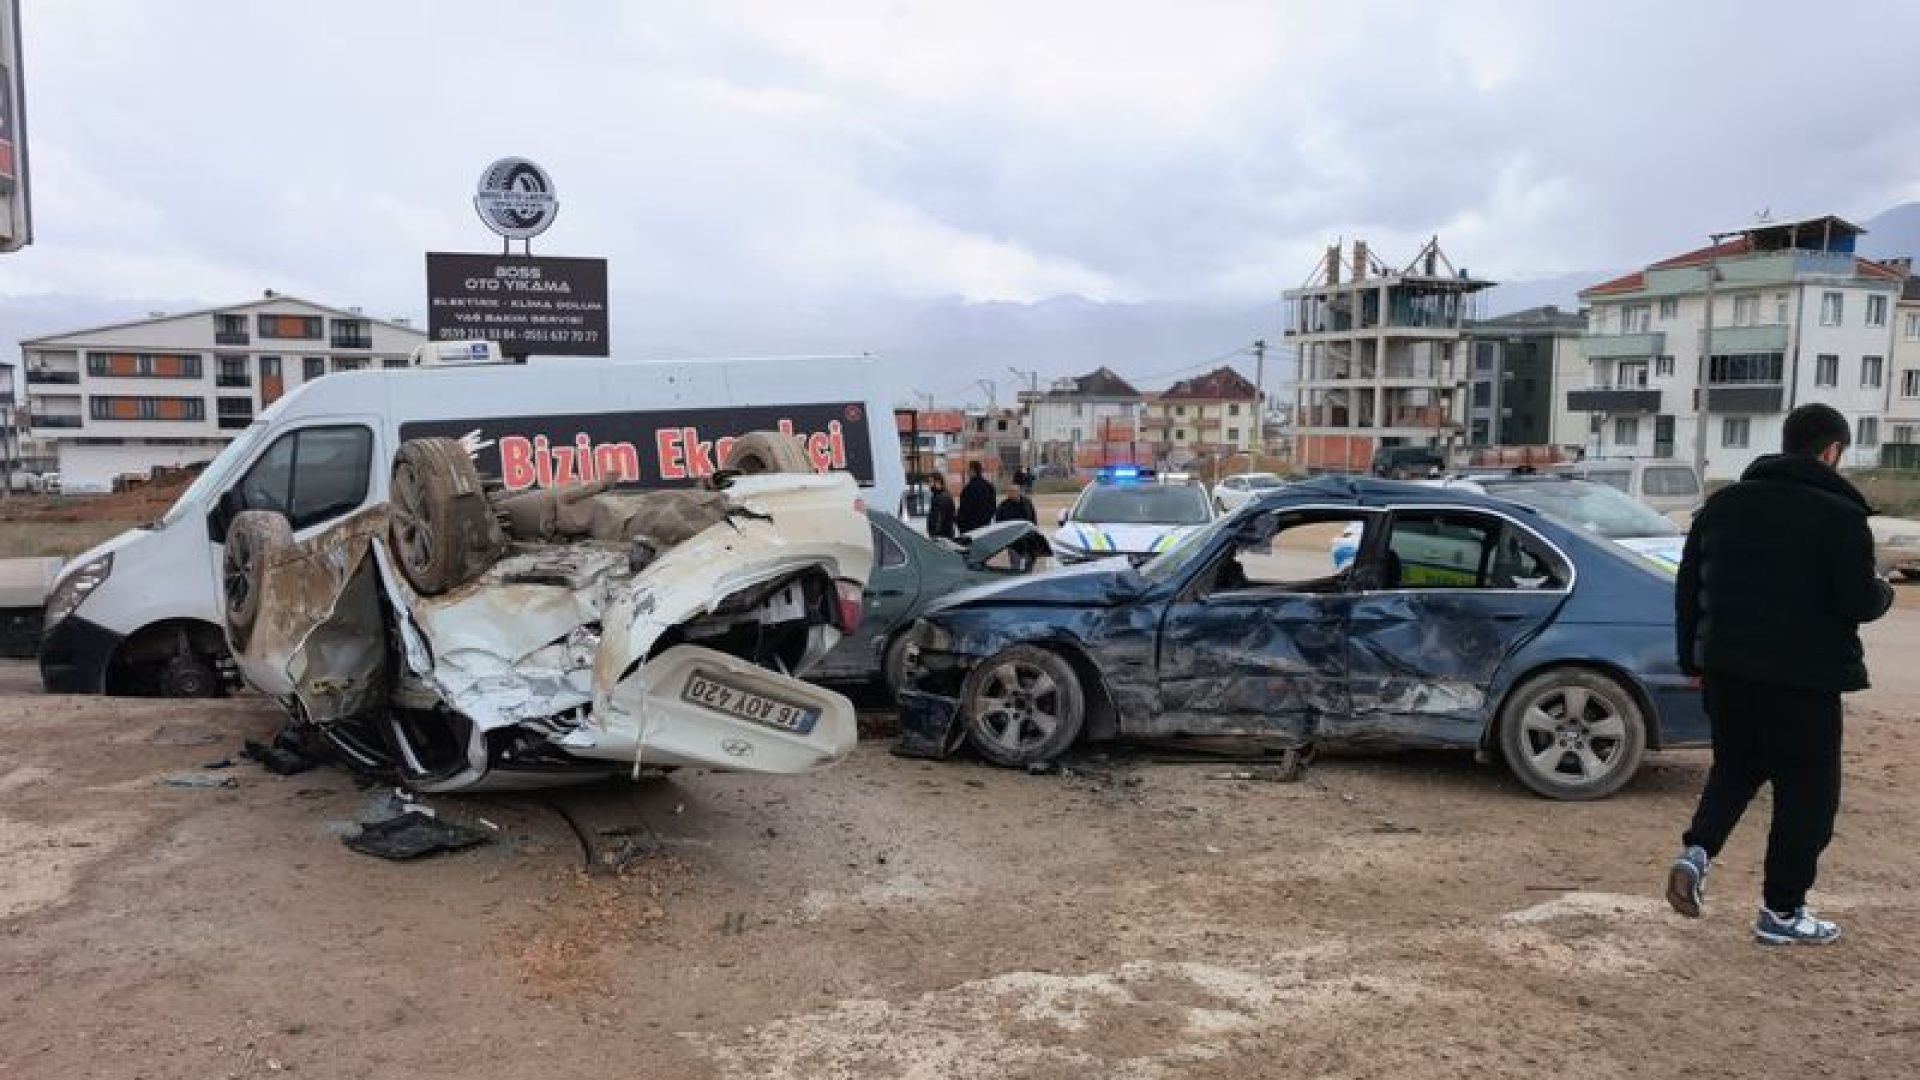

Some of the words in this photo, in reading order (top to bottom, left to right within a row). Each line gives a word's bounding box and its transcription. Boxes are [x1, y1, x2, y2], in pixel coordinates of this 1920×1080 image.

[496, 266, 541, 279] BOSS
[465, 278, 500, 291] OTO
[503, 279, 571, 294] YIKAMA
[499, 432, 639, 490] Bizim
[655, 419, 847, 478] Ekçi
[692, 680, 732, 707] 420
[777, 706, 800, 727] 16
